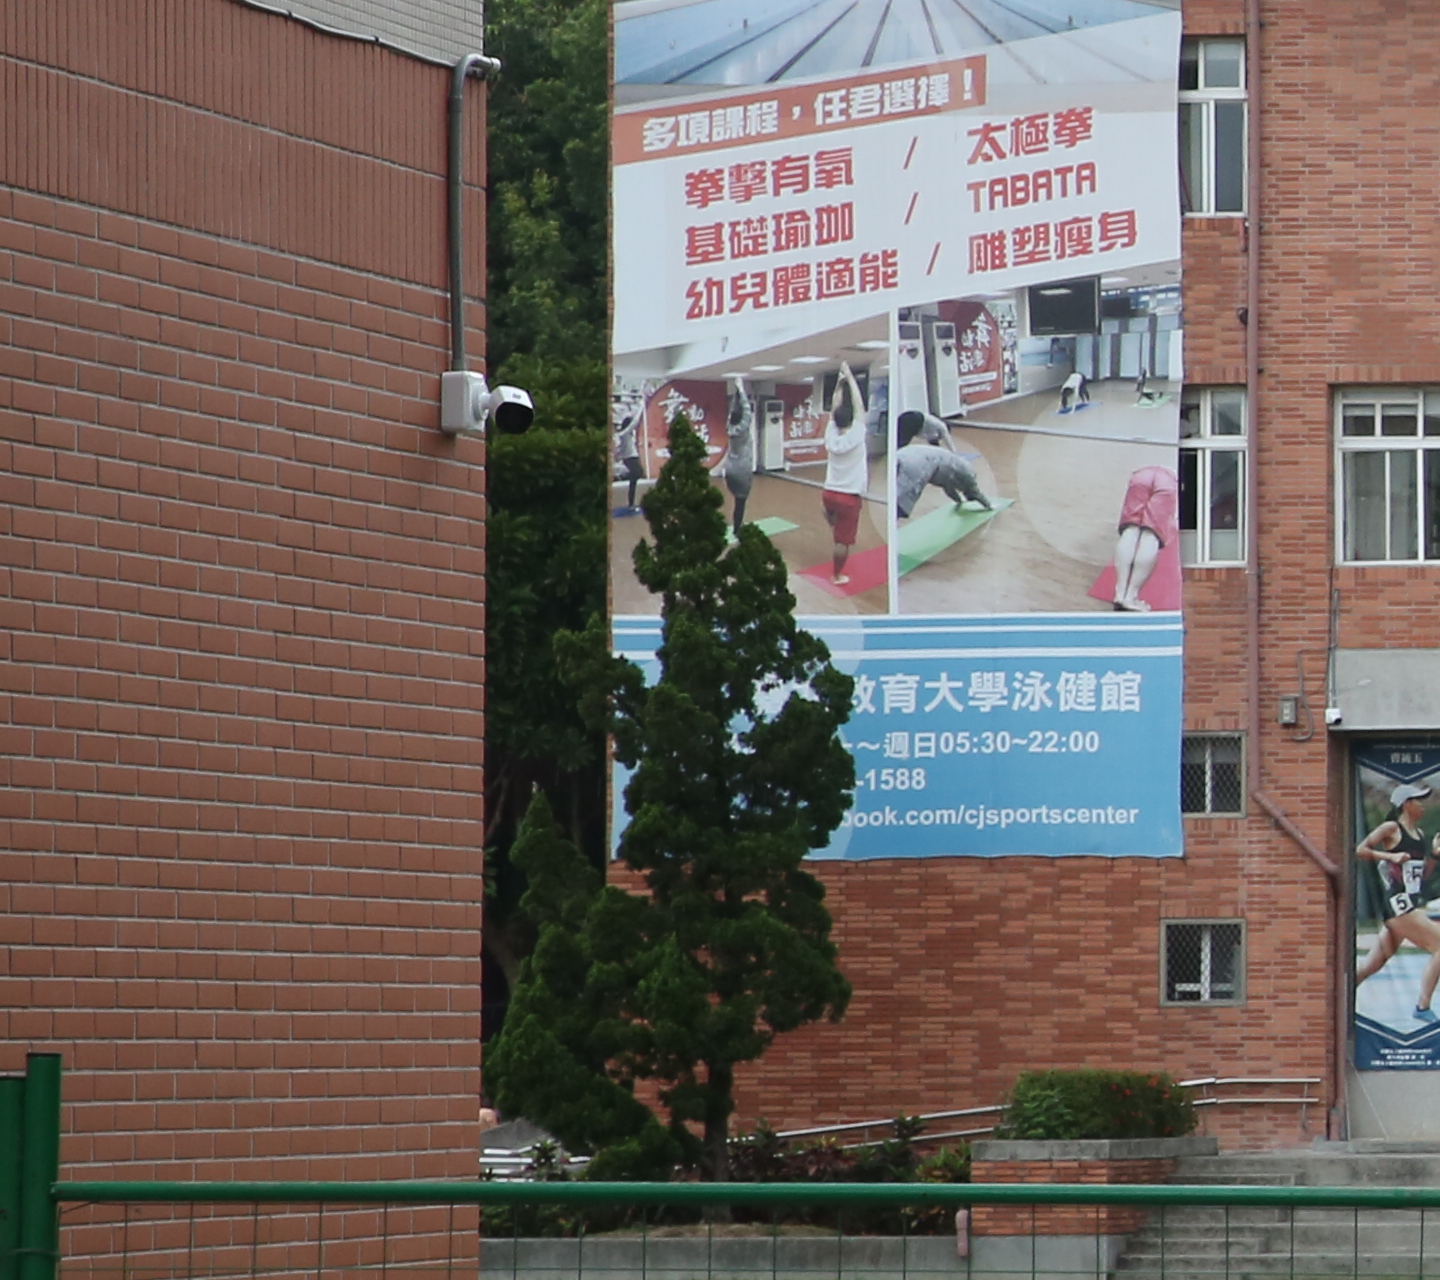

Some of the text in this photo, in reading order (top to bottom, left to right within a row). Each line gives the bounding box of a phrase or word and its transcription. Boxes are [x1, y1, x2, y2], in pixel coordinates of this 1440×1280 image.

[685, 146, 855, 209] 拳擊有氧
[967, 107, 1094, 166] 太極拳
[685, 201, 855, 266] 基礎瑜珈
[966, 162, 1097, 214] TABATA
[685, 249, 898, 320] 幼兒體適能
[967, 209, 1138, 274] 雕塑瘦身
